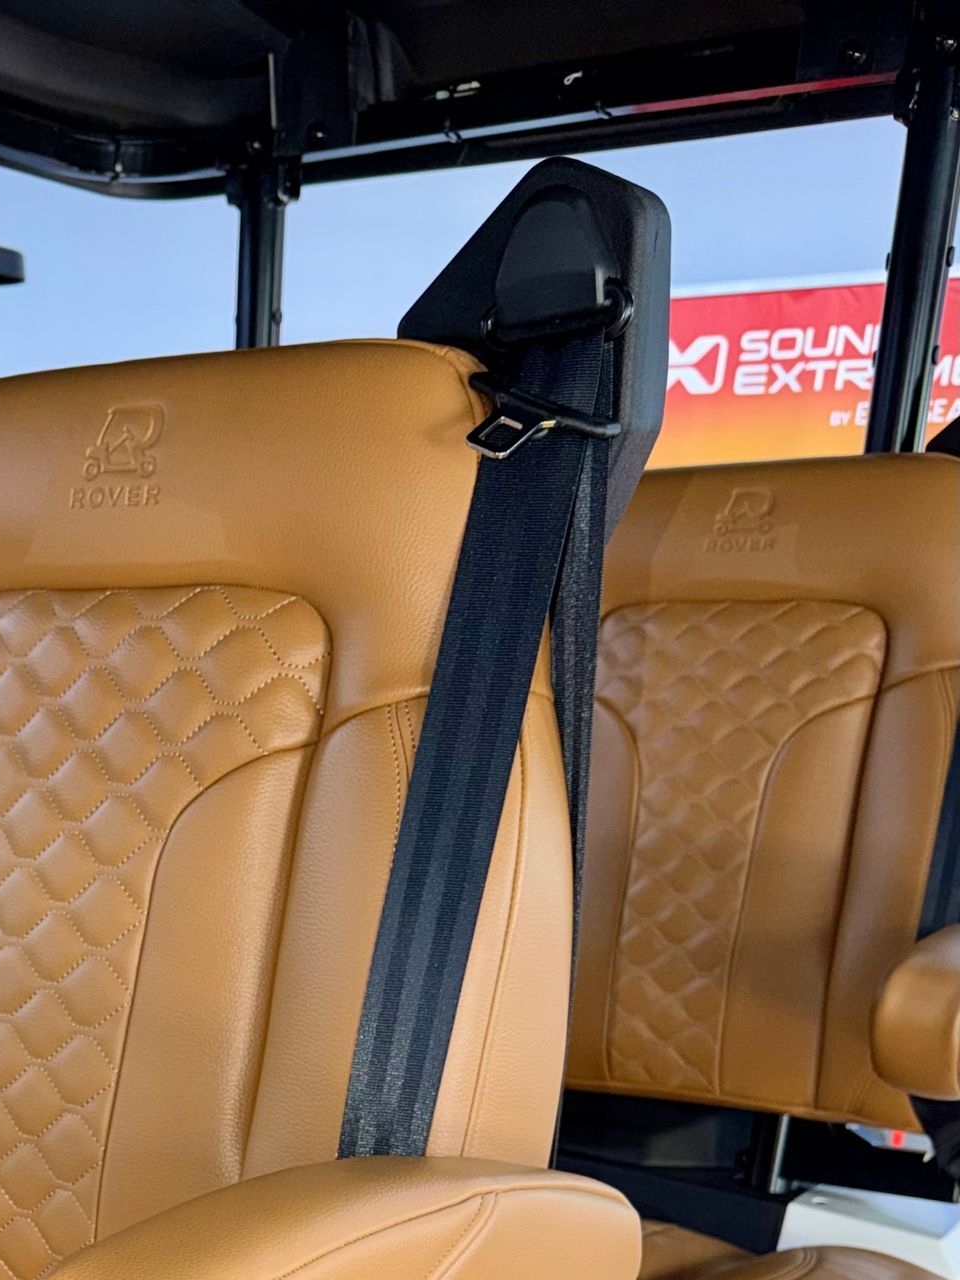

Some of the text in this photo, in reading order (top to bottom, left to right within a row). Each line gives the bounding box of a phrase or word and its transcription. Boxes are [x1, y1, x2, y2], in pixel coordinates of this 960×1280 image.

[739, 323, 881, 361] SOUN
[733, 354, 960, 395] EXTR
[829, 411, 851, 427] BY
[69, 485, 161, 509] ROVER
